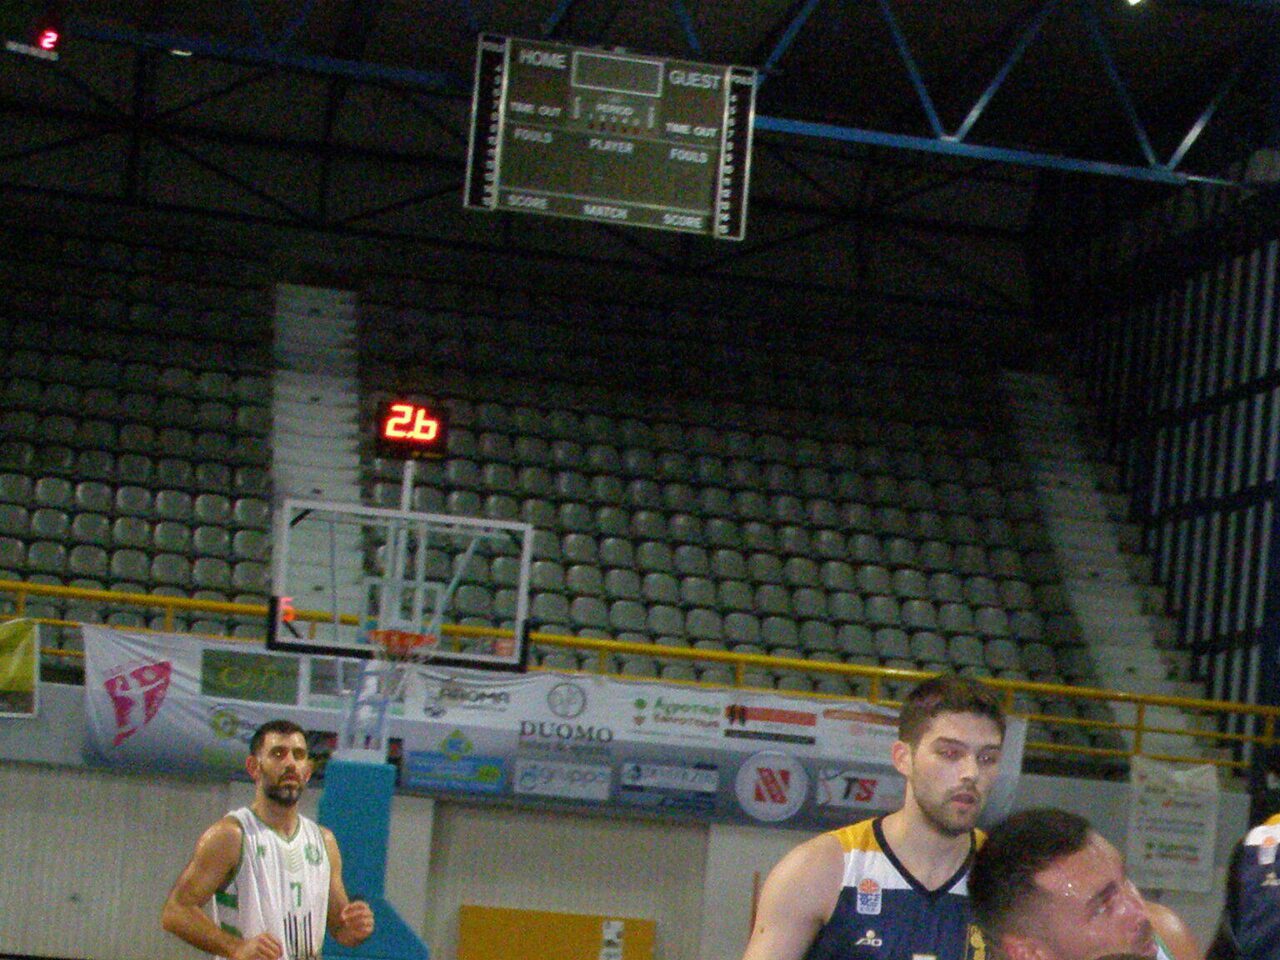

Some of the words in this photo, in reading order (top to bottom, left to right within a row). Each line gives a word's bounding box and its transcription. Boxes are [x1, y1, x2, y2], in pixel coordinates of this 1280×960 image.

[519, 51, 566, 69] HOME
[669, 70, 721, 89] GUEST
[693, 125, 719, 139] OUT
[519, 720, 614, 743] DUOMO
